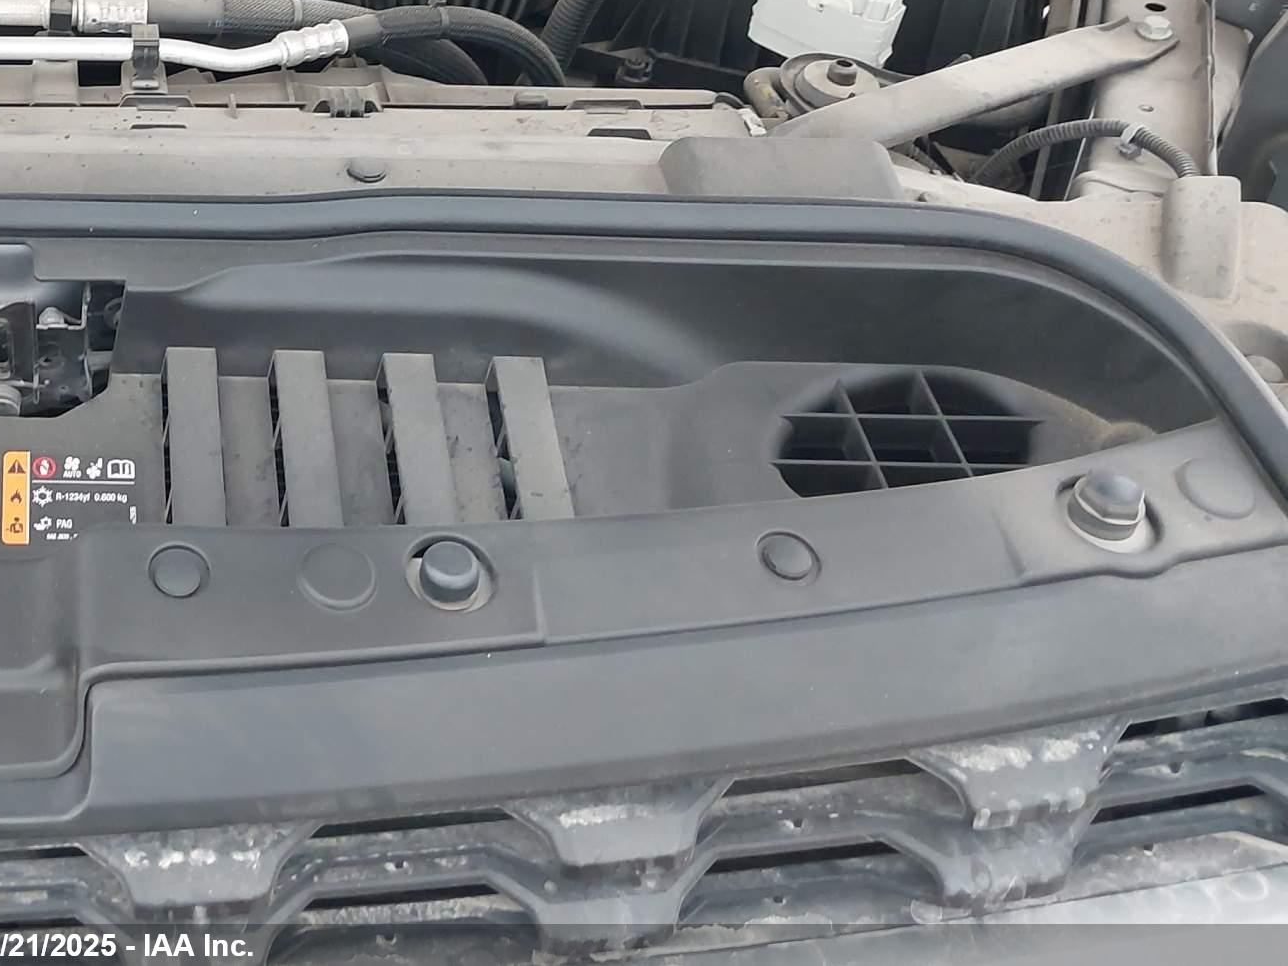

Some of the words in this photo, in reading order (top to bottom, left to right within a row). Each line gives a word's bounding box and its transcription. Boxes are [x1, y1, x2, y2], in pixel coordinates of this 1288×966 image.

[63, 470, 82, 479] AUTO
[117, 492, 128, 504] kg
[56, 518, 73, 529] PAG
